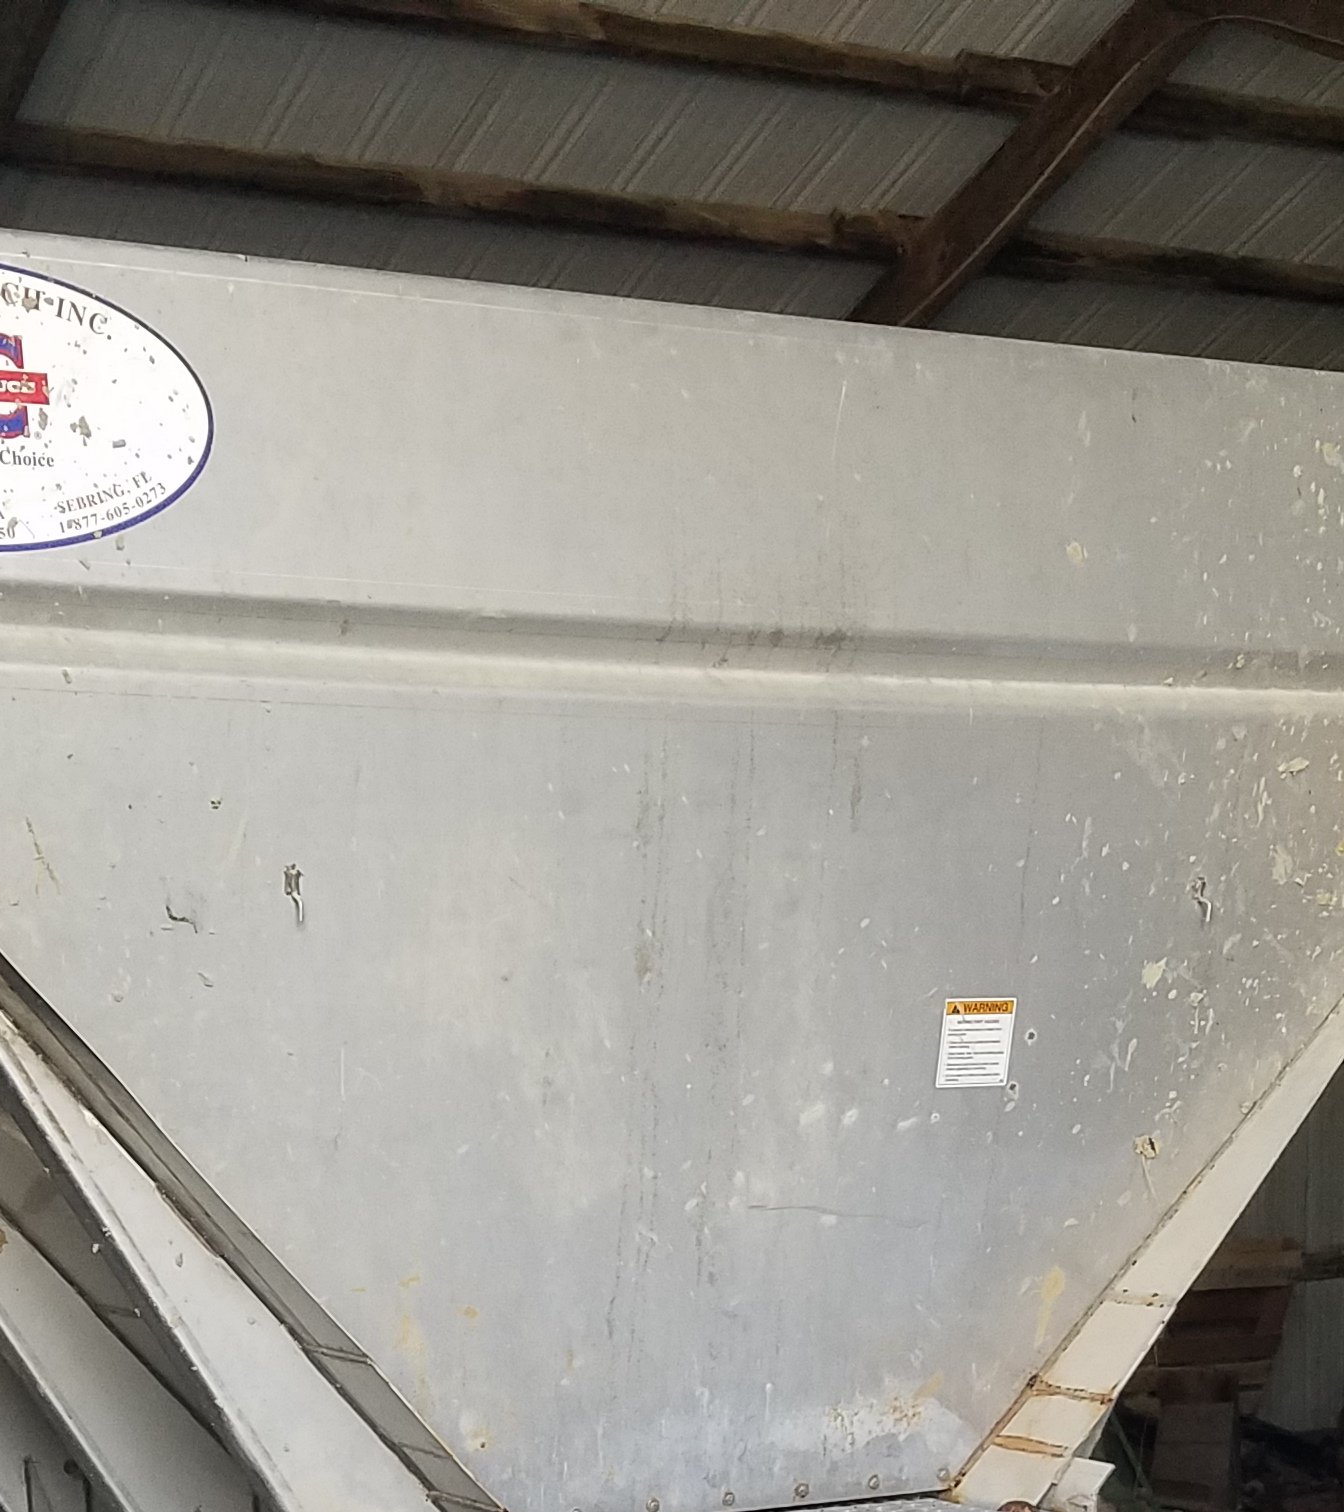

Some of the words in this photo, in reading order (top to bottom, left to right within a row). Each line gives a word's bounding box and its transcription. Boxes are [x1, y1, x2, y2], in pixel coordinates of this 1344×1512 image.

[55, 296, 112, 340] INC.
[0, 448, 55, 467] Choice
[963, 1002, 1009, 1013] WARNING
